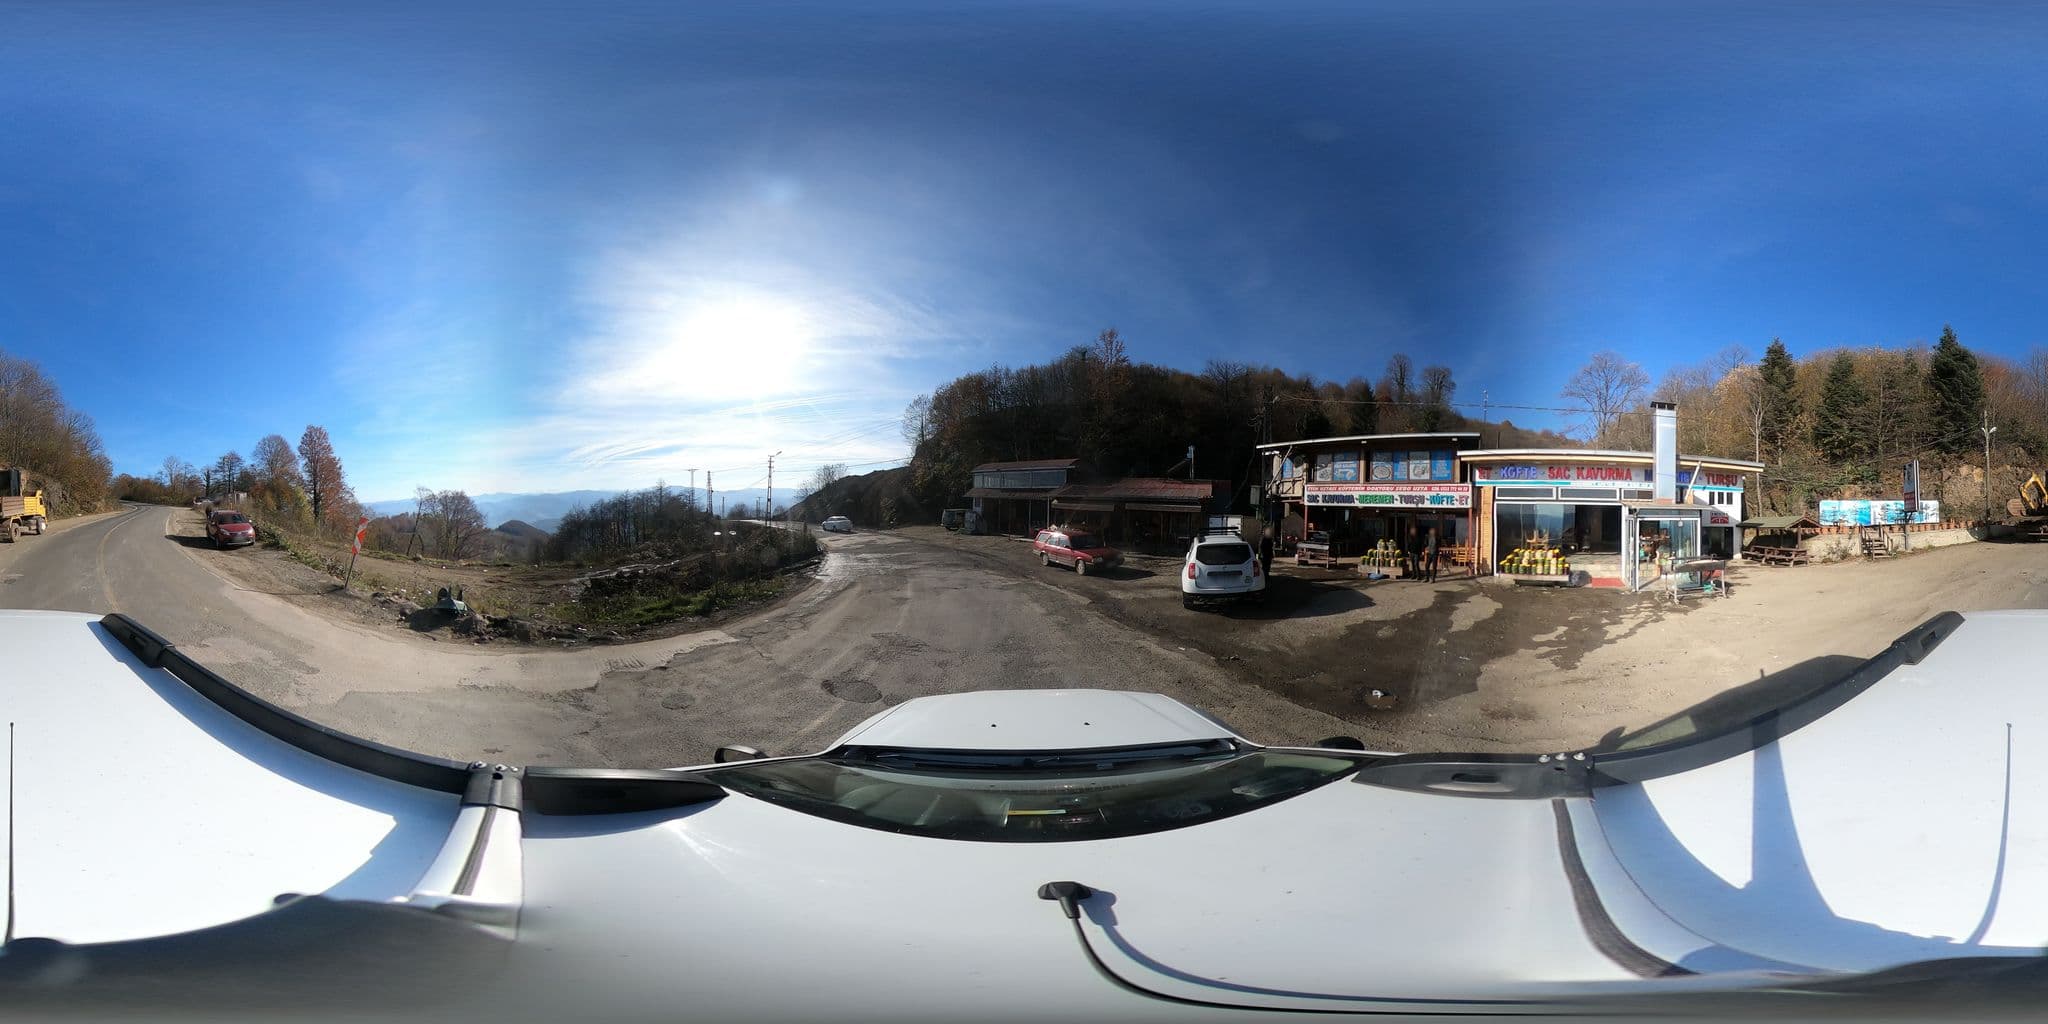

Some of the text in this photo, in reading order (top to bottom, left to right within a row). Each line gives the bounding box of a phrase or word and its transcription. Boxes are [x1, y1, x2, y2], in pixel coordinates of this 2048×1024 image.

[1548, 466, 1570, 479] SAC
[1576, 466, 1632, 481] KAVURMA
[1705, 472, 1738, 487] TURŞU
[1322, 494, 1355, 504] KAVURMA
[1398, 495, 1425, 507] TURŞU
[1429, 493, 1455, 505] KÖFTE
